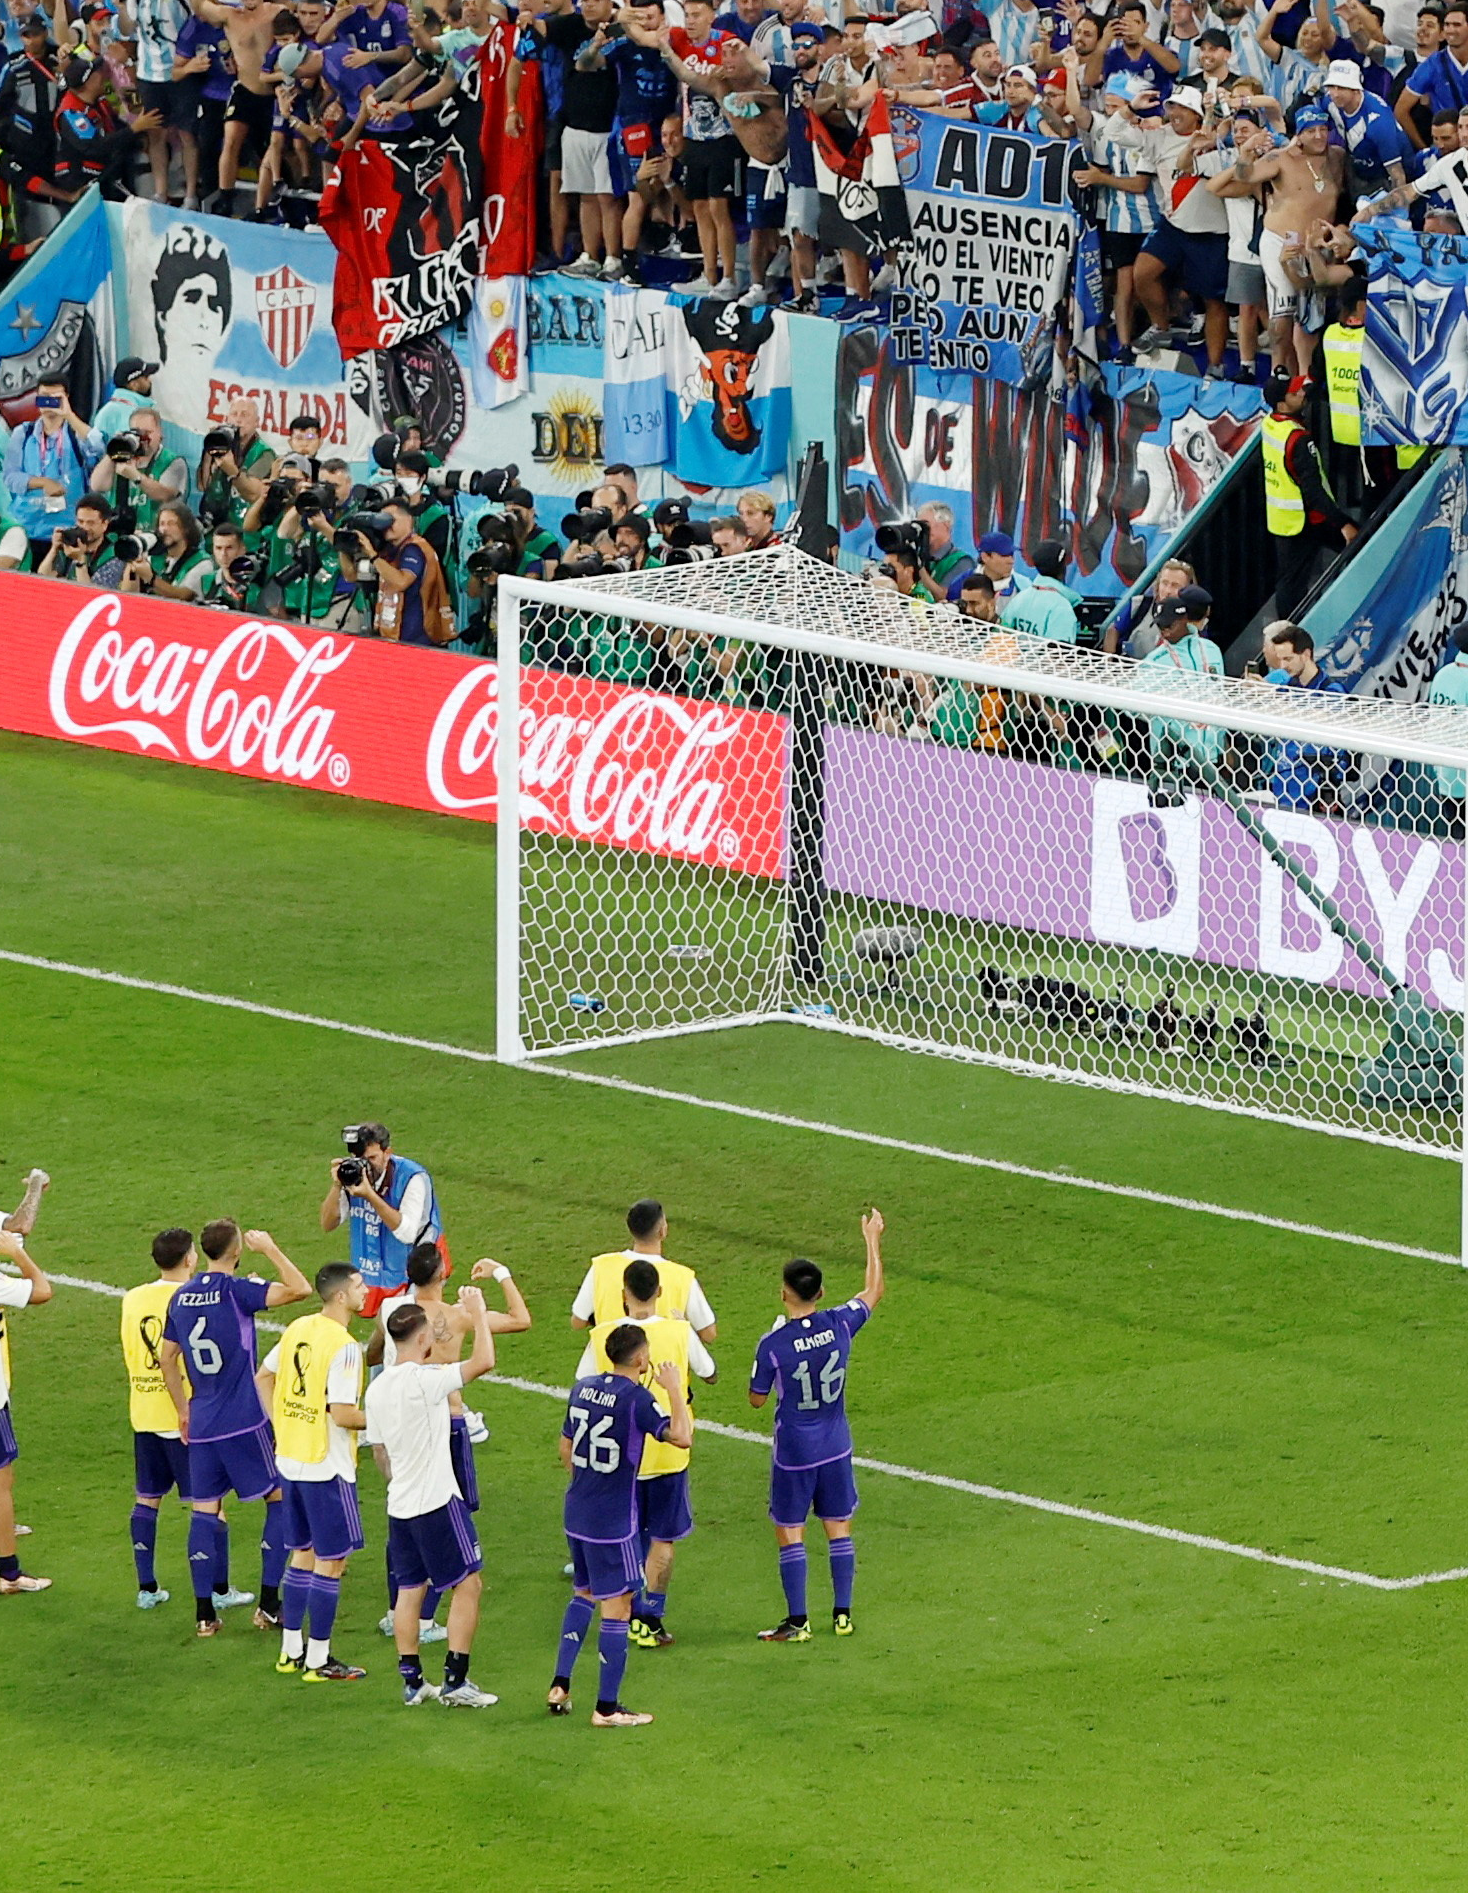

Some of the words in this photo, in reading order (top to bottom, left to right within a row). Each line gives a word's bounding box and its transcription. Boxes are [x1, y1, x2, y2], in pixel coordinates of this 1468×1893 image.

[913, 200, 1071, 251] AUSENCIA
[954, 240, 981, 270] EL
[988, 241, 1055, 282] VIENTO
[951, 273, 985, 304] TE
[994, 279, 1046, 315] VEO
[958, 311, 1029, 346] AUN
[50, 594, 355, 782] Coca-Cola
[188, 1315, 223, 1375] 6
[793, 1332, 835, 1354] ALMADA
[578, 1385, 617, 1409] MOLINA
[793, 1350, 846, 1411] 16
[569, 1406, 621, 1474] 26
